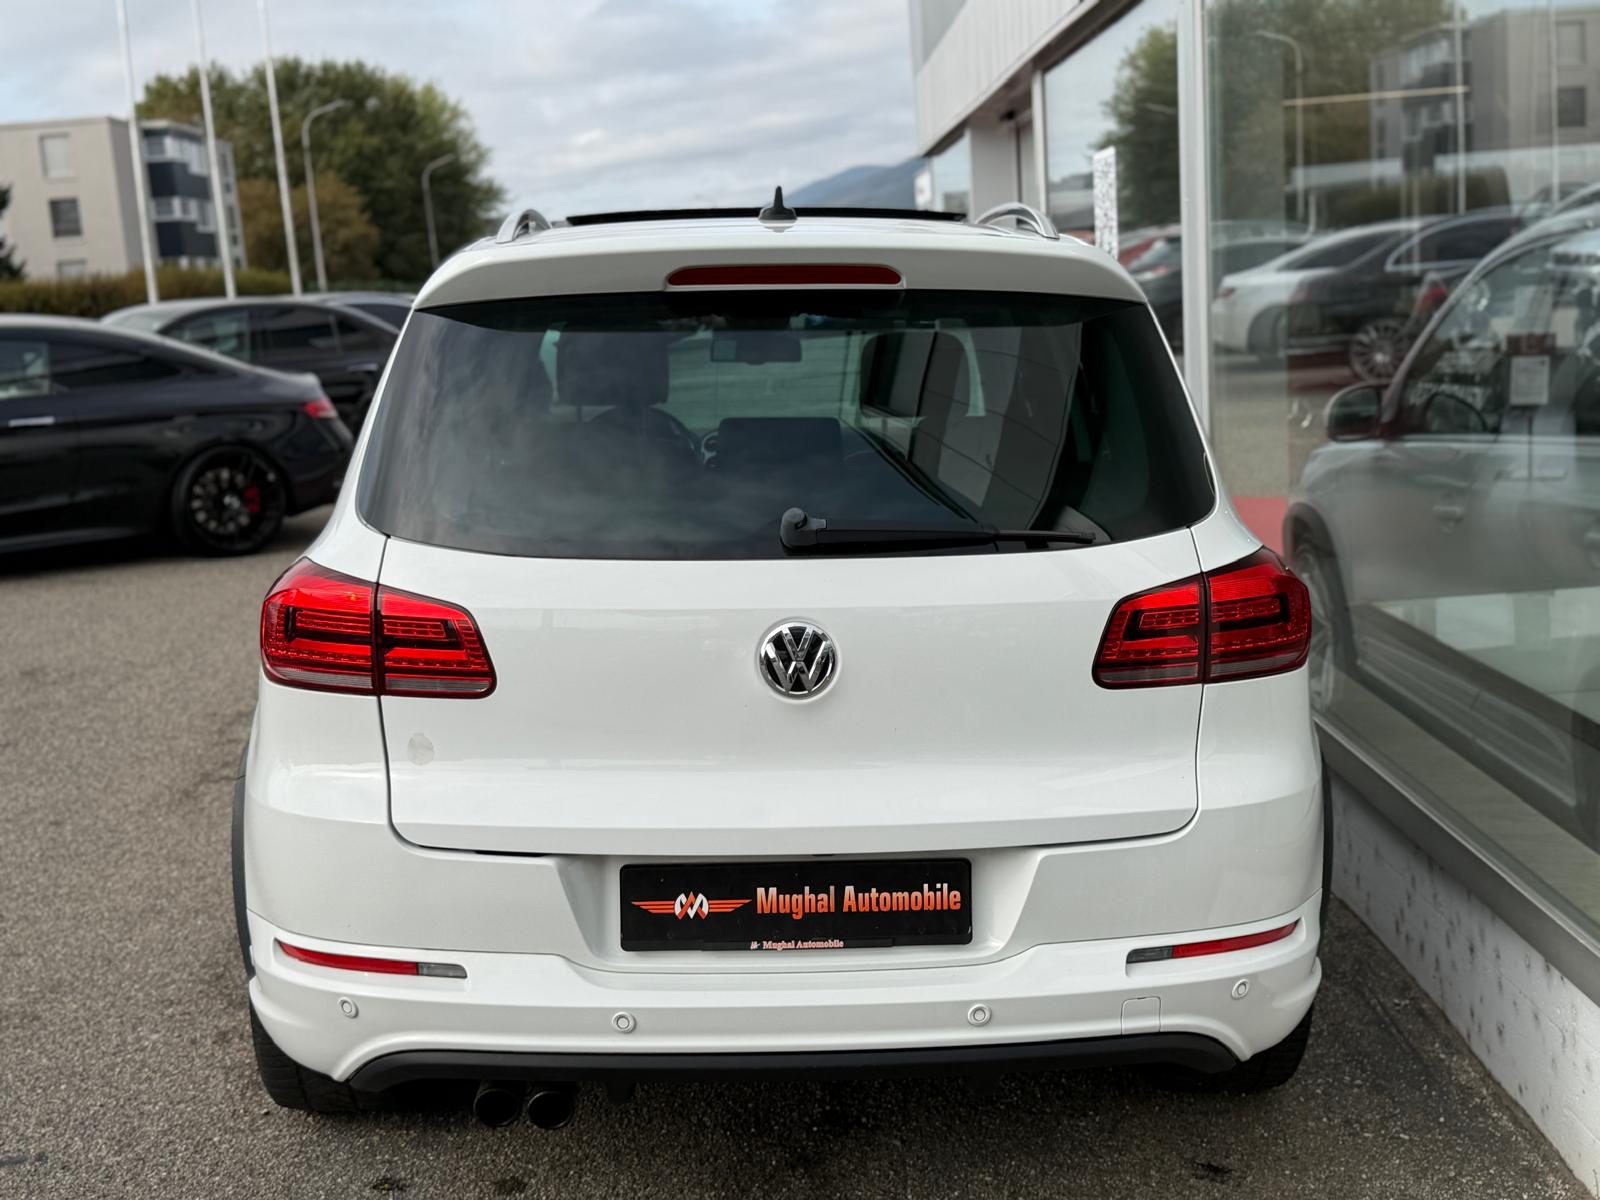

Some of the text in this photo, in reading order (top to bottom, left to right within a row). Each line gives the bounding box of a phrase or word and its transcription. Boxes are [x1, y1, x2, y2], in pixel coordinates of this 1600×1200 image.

[756, 883, 962, 920] Mughal Automobile
[762, 939, 844, 951] Mughal Automobile
